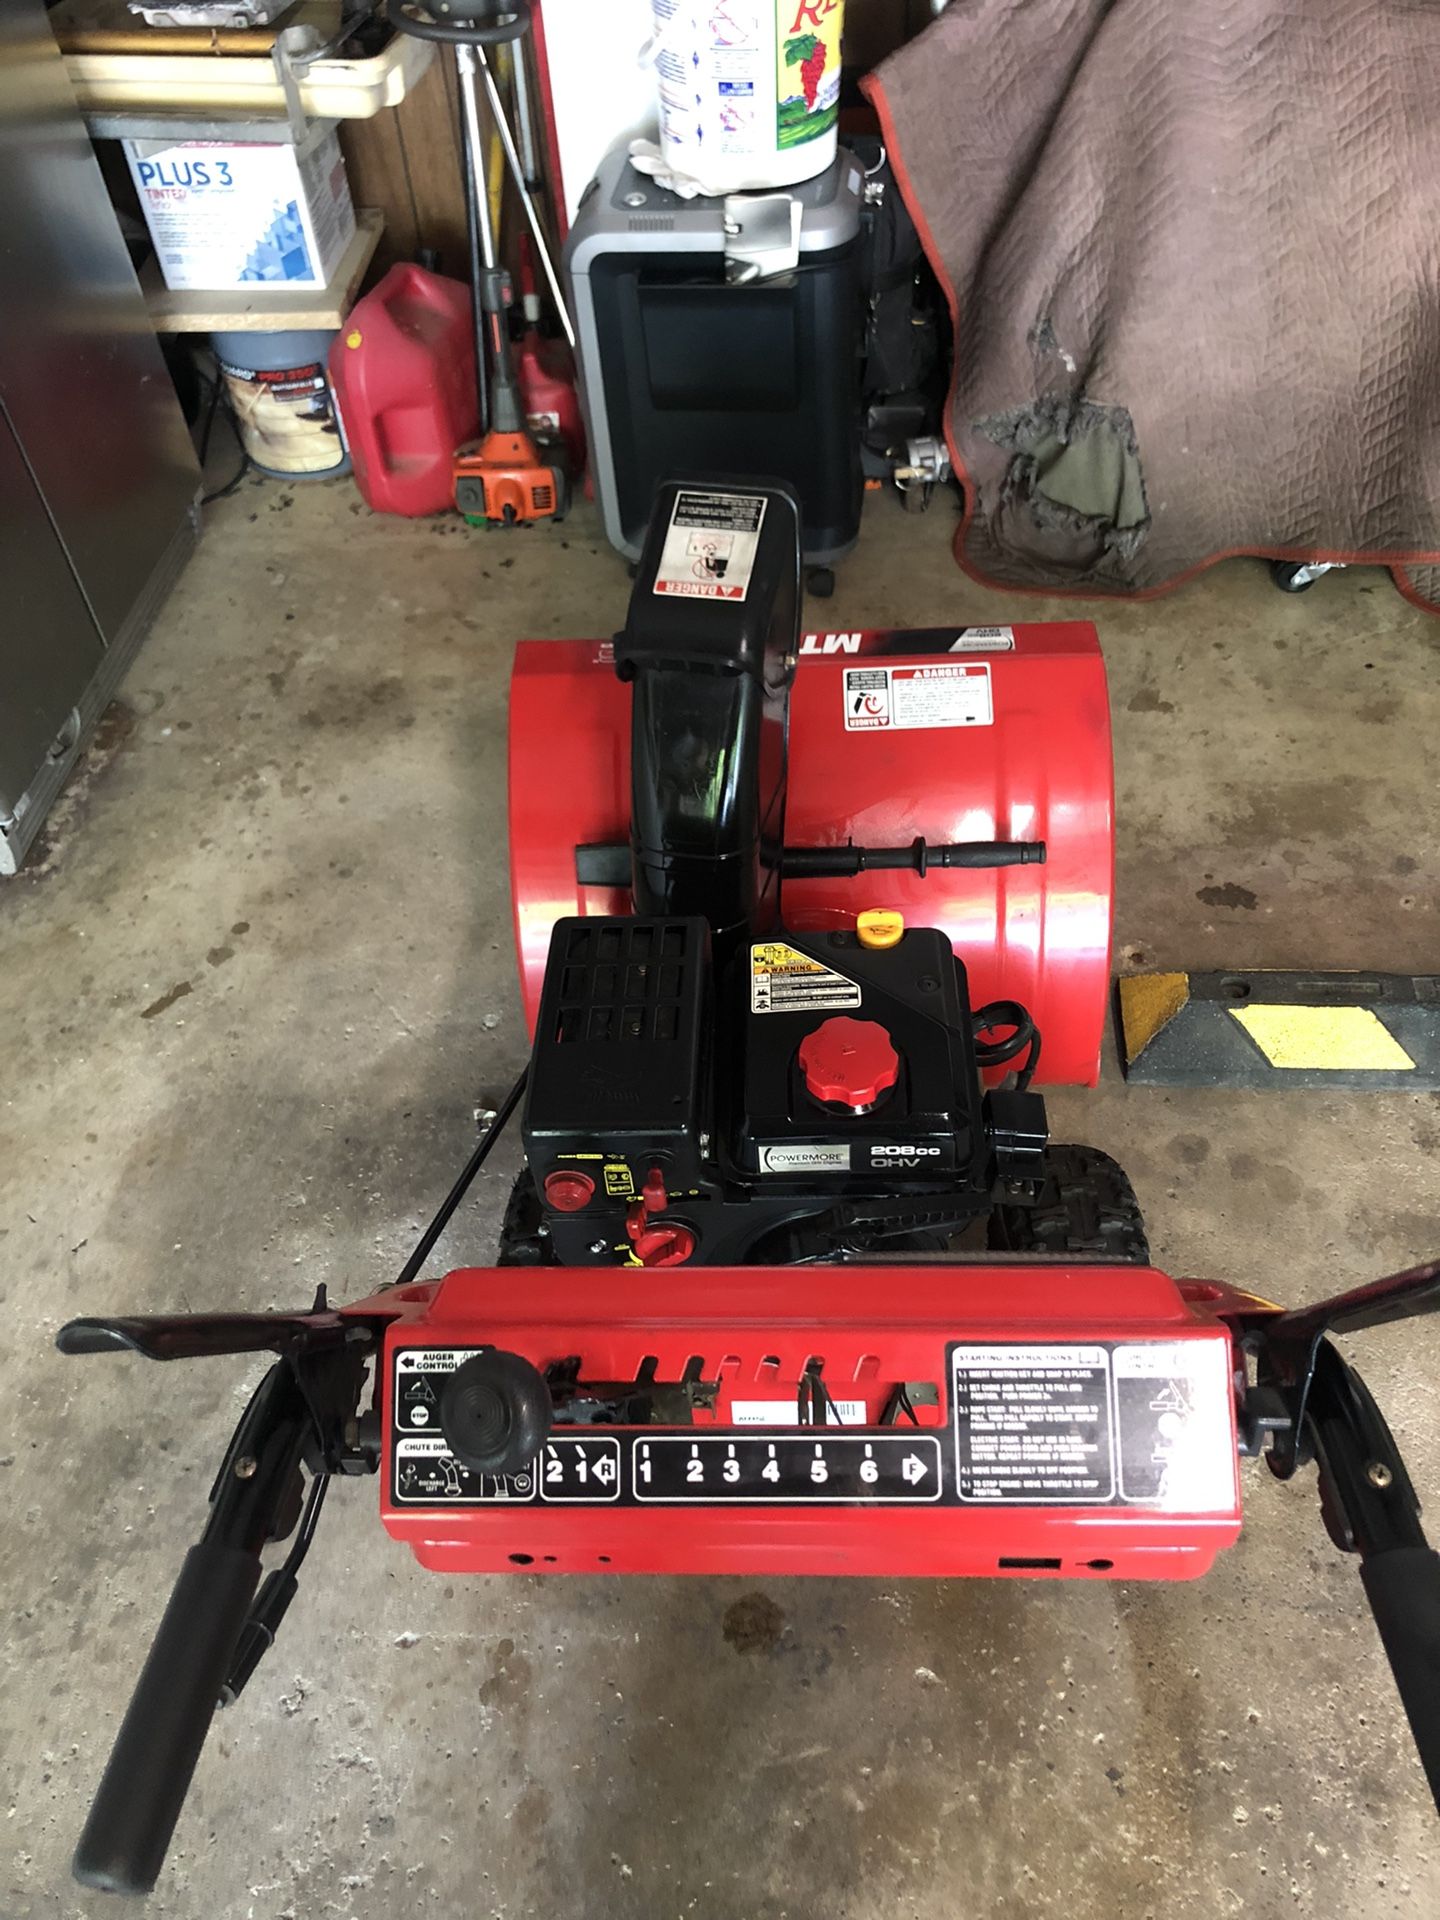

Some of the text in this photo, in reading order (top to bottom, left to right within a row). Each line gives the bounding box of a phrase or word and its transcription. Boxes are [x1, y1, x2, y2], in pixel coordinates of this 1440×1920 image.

[137, 162, 233, 186] PLUS 3
[666, 582, 717, 595] DANGER
[923, 667, 967, 678] DANGER
[771, 964, 812, 973] WARNING
[870, 1146, 941, 1156] 208cc
[770, 1153, 841, 1162] POWERMORE
[870, 1158, 921, 1167] OHV
[423, 1353, 454, 1361] AUGER
[404, 1443, 431, 1451] CHUTE
[546, 1460, 612, 1482] 2 1 R
[639, 1460, 917, 1483] 1 2 3 4 5 6 F
